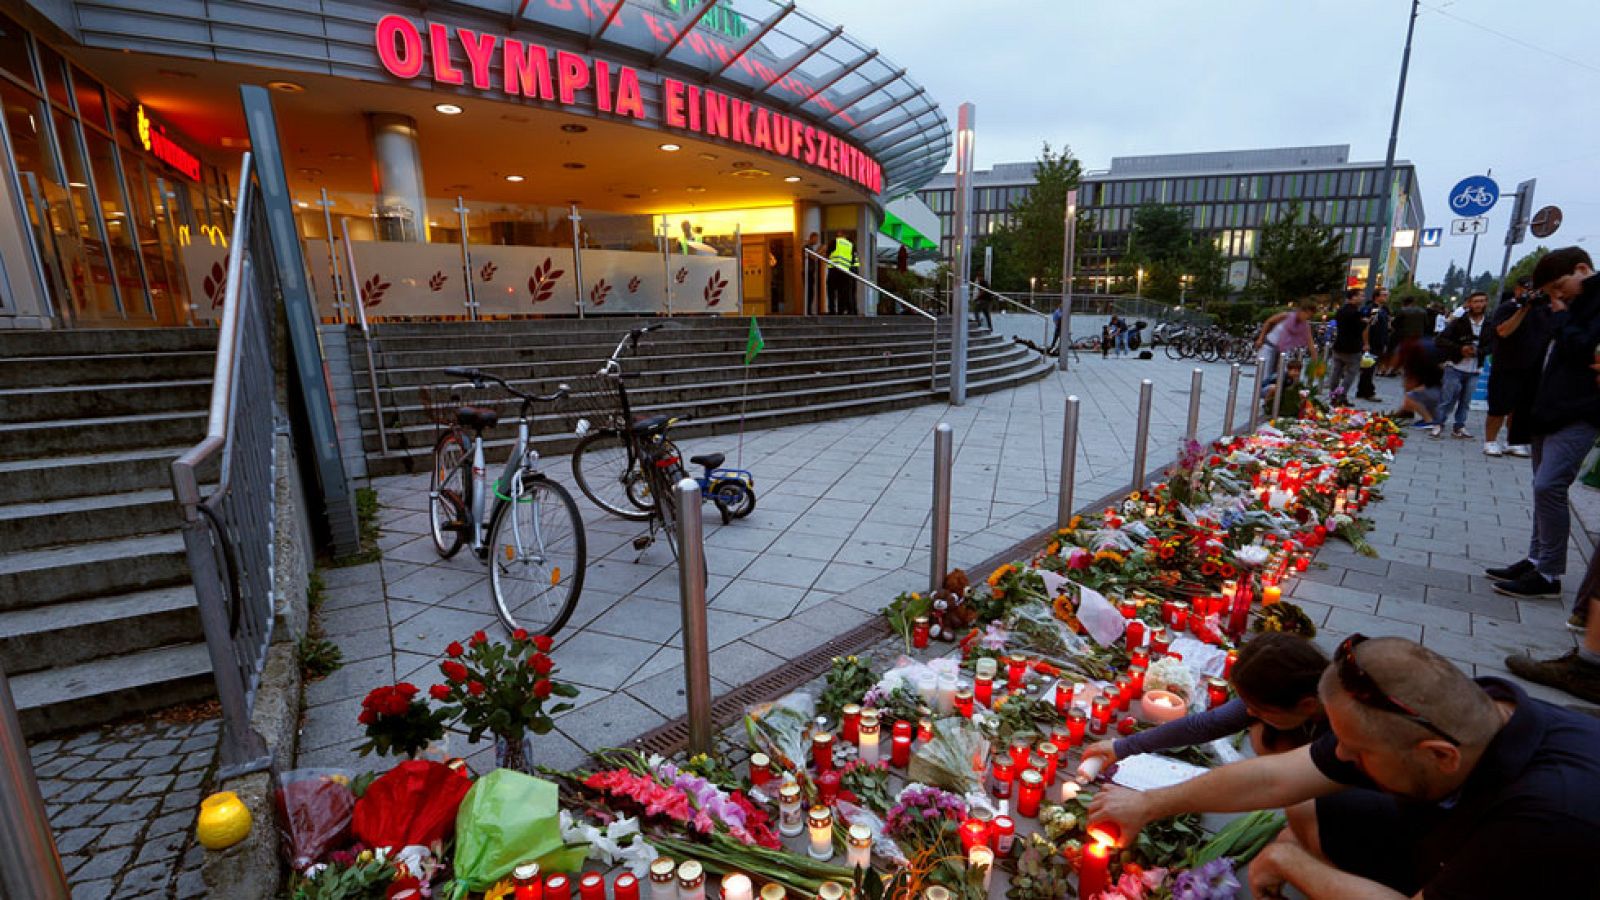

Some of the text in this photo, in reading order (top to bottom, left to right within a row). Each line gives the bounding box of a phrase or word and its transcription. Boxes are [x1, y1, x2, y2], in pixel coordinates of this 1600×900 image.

[375, 13, 645, 120] OLYMPIA
[664, 77, 882, 196] EINKAUFSZENTRUM
[1424, 231, 1438, 246] U
